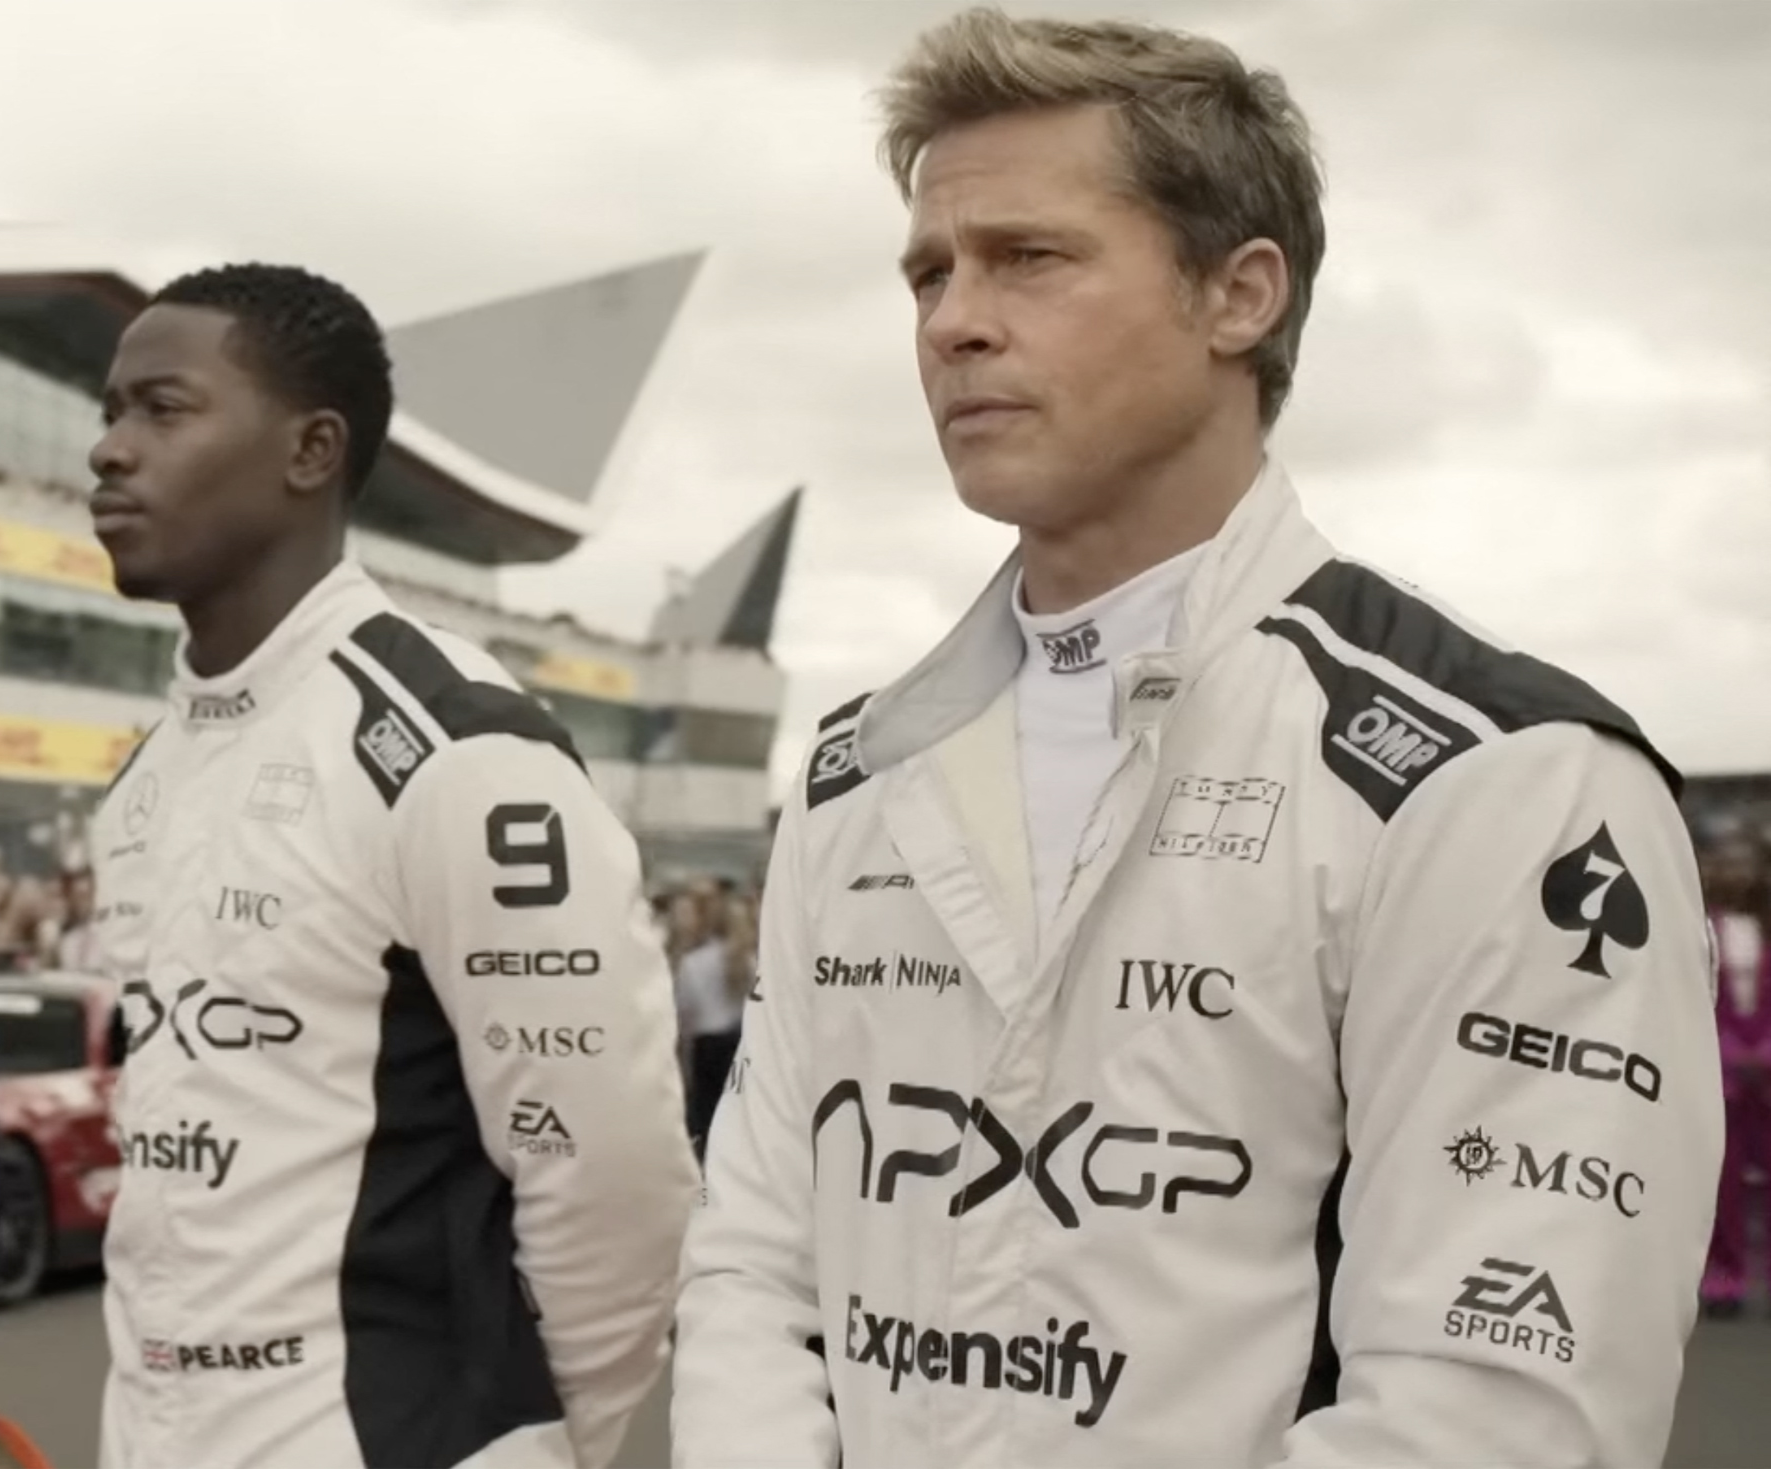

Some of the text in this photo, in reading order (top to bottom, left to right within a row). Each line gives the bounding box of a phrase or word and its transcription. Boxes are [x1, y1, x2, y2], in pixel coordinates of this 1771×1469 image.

[365, 717, 419, 776] OMP
[1345, 706, 1437, 776] OMP
[485, 802, 571, 909] 9
[1578, 850, 1626, 921] 7
[214, 885, 283, 931] IWC
[465, 948, 602, 978] GEICO
[1114, 959, 1236, 1019] IWC
[518, 1025, 606, 1058] MSC
[1456, 1012, 1662, 1102] GEICO
[508, 1132, 577, 1158] SPORTS
[509, 1099, 571, 1139] EA
[116, 1119, 242, 1190] nsify
[1510, 1142, 1646, 1219] MSC
[1452, 1257, 1575, 1333] EA
[177, 1336, 305, 1371] PEARCE
[845, 1294, 1127, 1428] Expensify
[1444, 1310, 1577, 1363] SPORTS
